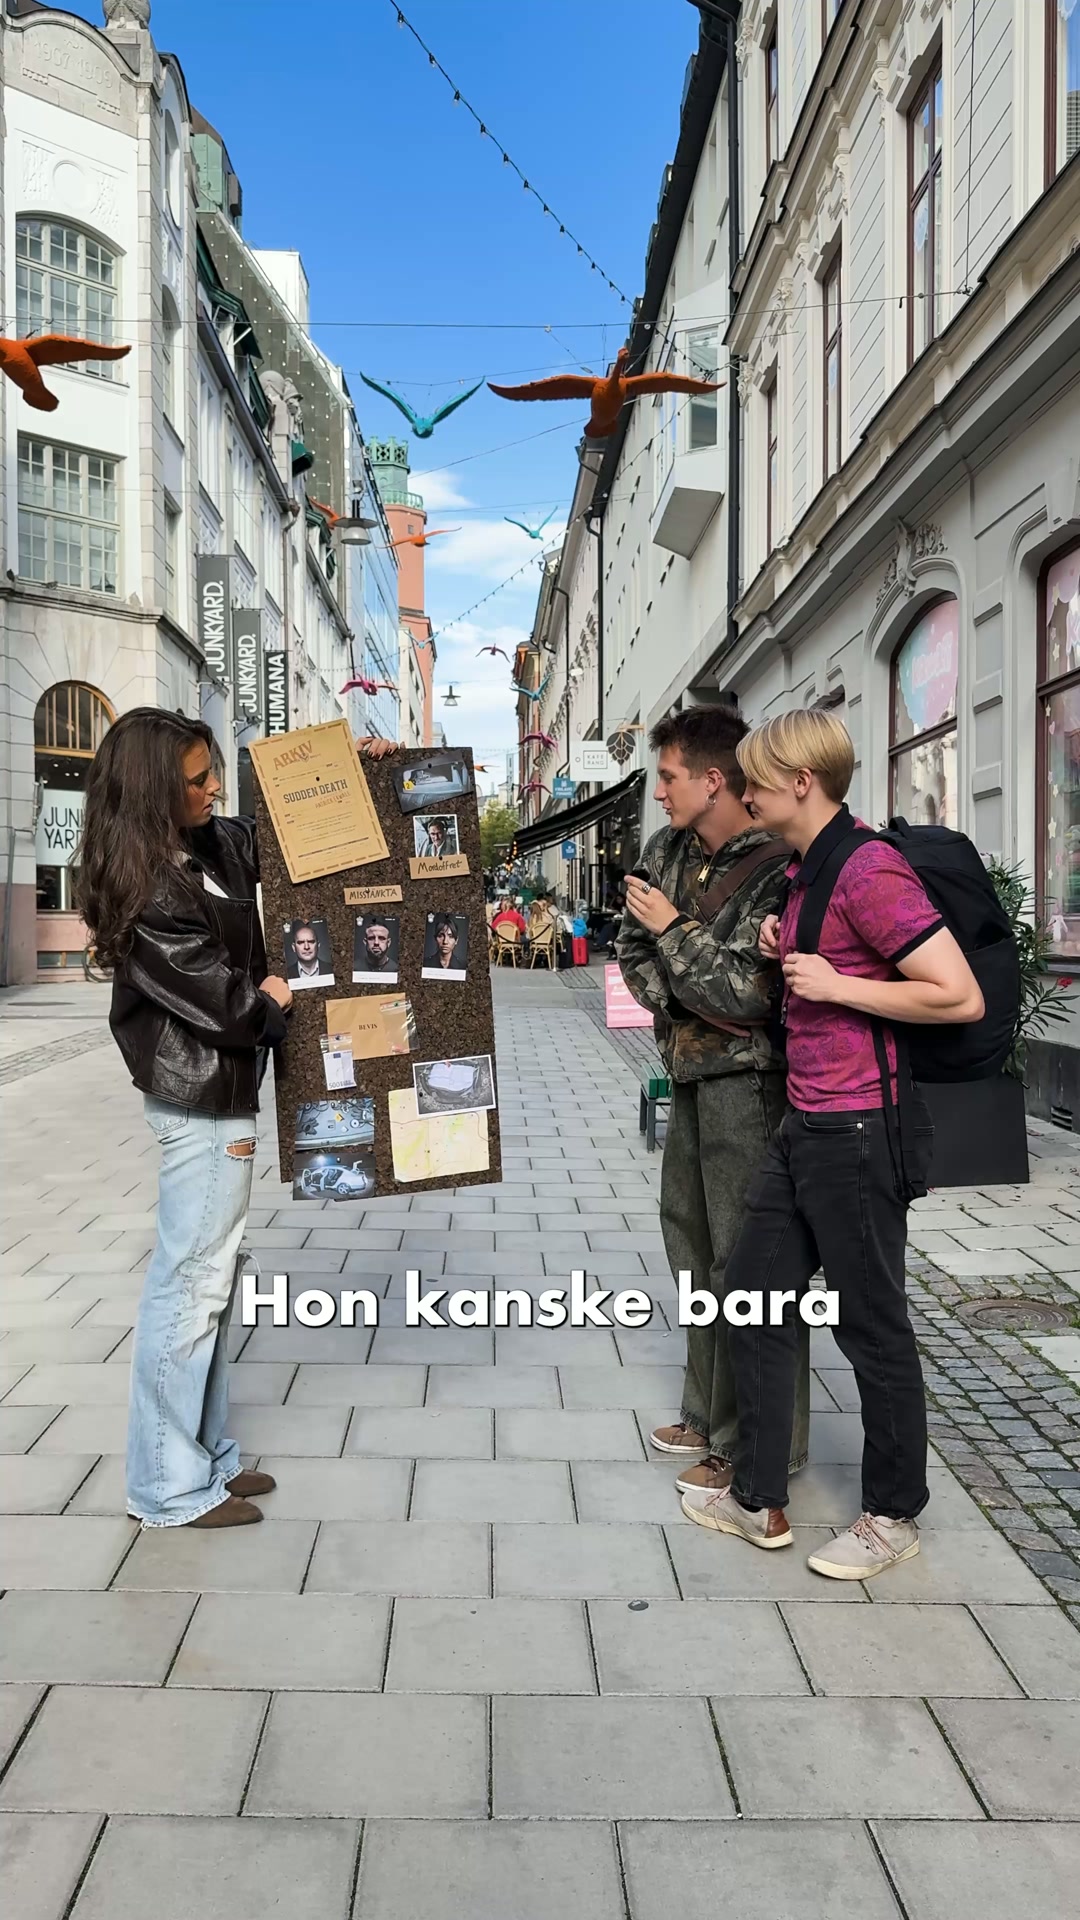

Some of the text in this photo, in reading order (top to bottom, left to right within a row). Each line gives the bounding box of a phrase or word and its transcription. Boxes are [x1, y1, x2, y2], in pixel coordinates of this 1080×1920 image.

[202, 580, 226, 673] JUNKYARD.
[237, 633, 257, 713] JUNKYARD.
[268, 653, 286, 734] HUMANA
[272, 740, 314, 771] ARKIV
[283, 786, 319, 804] SUDDEN
[319, 779, 348, 796] DEATH
[358, 1023, 378, 1031] BEVIS
